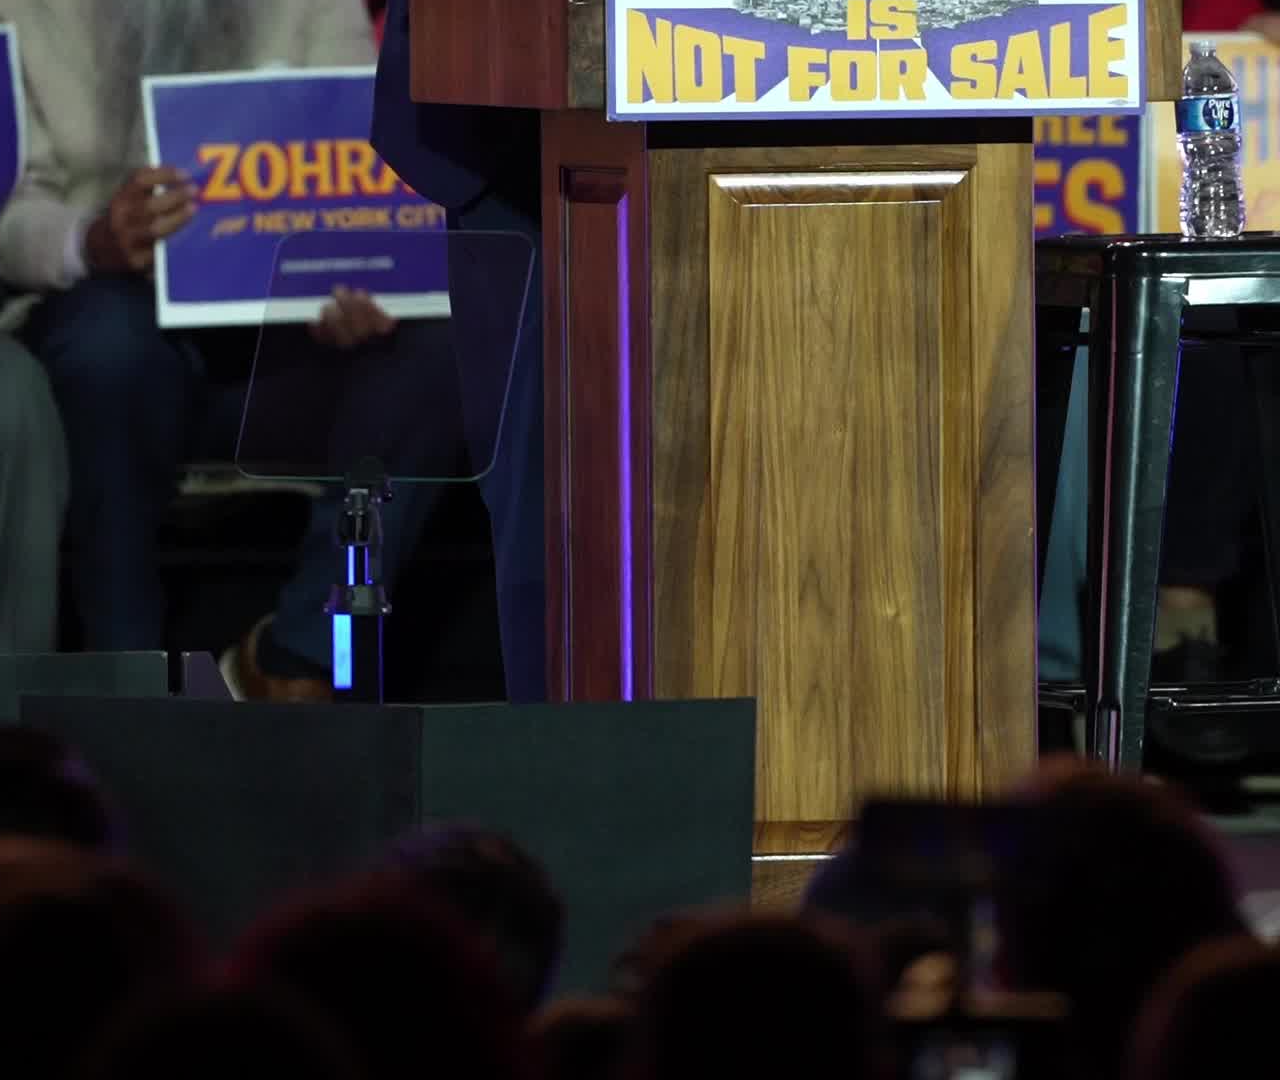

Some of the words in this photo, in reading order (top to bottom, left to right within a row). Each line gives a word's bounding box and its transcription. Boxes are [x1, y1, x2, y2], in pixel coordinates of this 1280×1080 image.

[627, 8, 765, 104] NOT
[788, 45, 928, 102] FOR
[950, 4, 1128, 100] SALE
[1208, 99, 1231, 110] Pure
[252, 209, 318, 235] NEW
[322, 206, 393, 230] YORK
